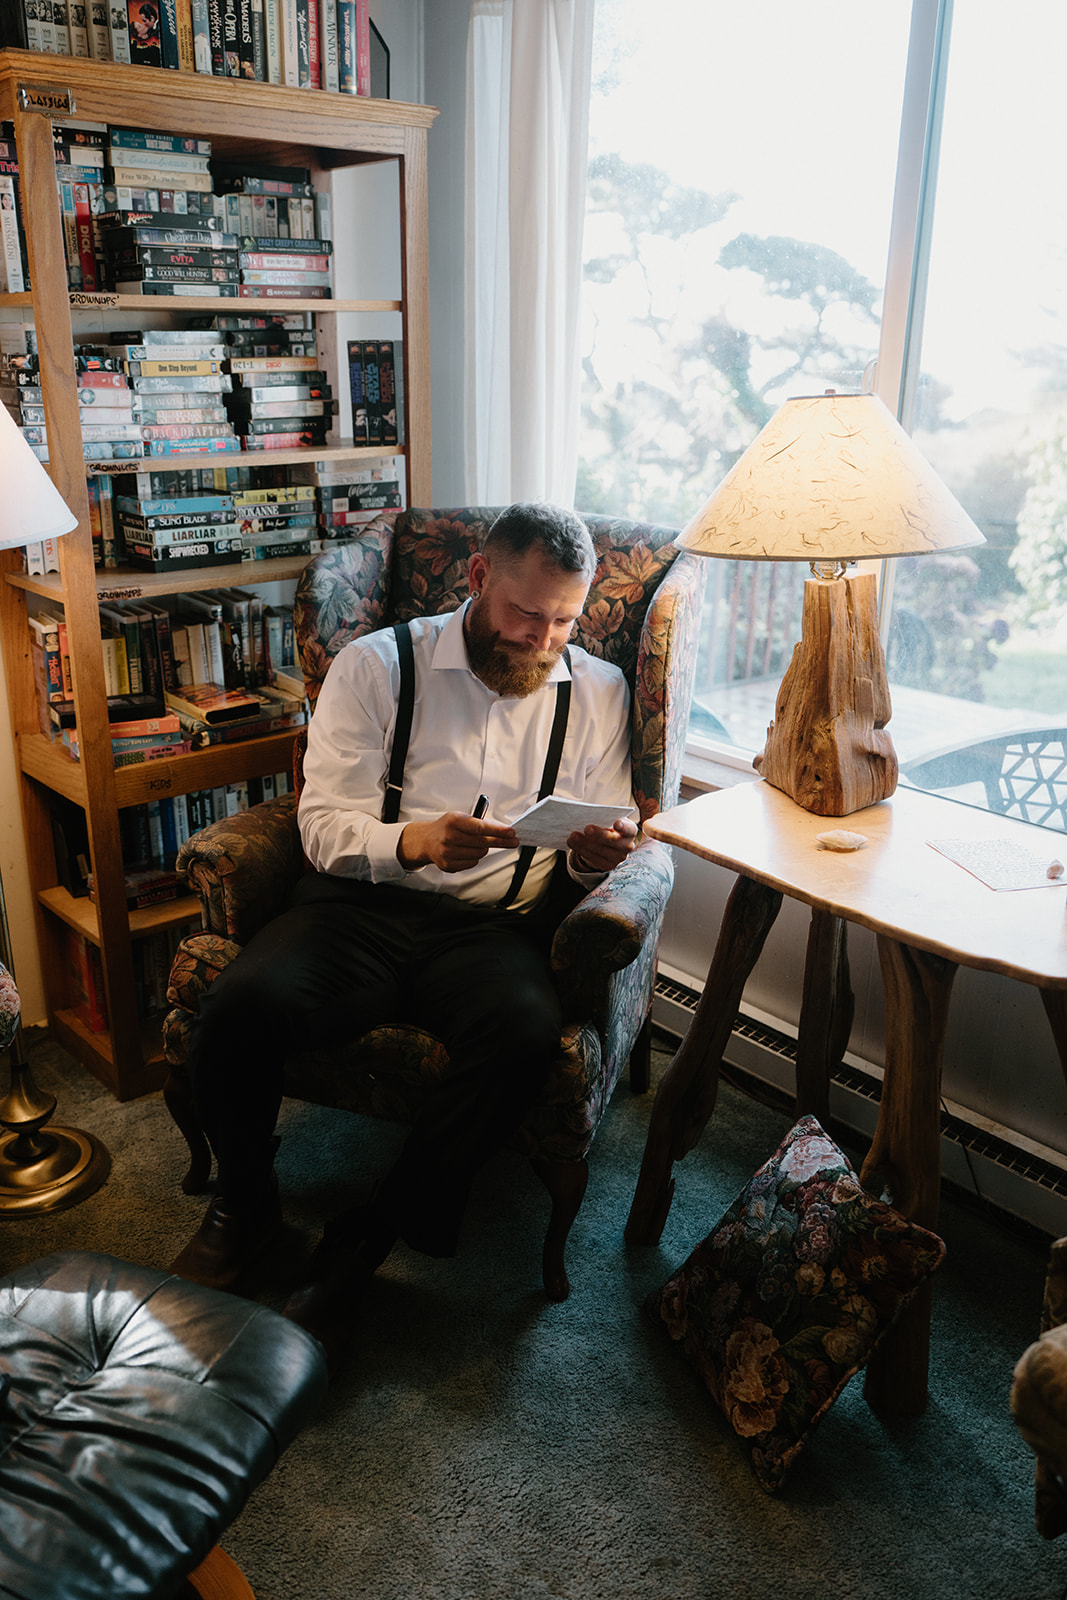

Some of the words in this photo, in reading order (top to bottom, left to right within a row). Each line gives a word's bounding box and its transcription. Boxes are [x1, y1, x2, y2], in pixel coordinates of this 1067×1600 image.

[308, 1, 316, 21] WEST
[224, 13, 238, 41] OPERA
[241, 0, 252, 43] AMADEUS
[309, 22, 317, 39] SIDE
[309, 40, 318, 64] STORY
[79, 225, 91, 254] DICK
[170, 255, 194, 264] EVITA
[157, 269, 174, 277] GOOD
[158, 364, 168, 372] One
[168, 364, 180, 373] Step
[180, 364, 198, 373] Beyond
[265, 359, 282, 370] gold
[152, 425, 215, 439] BACKDRAFT
[237, 504, 280, 518] ROXANNE
[183, 515, 207, 525] BLADE
